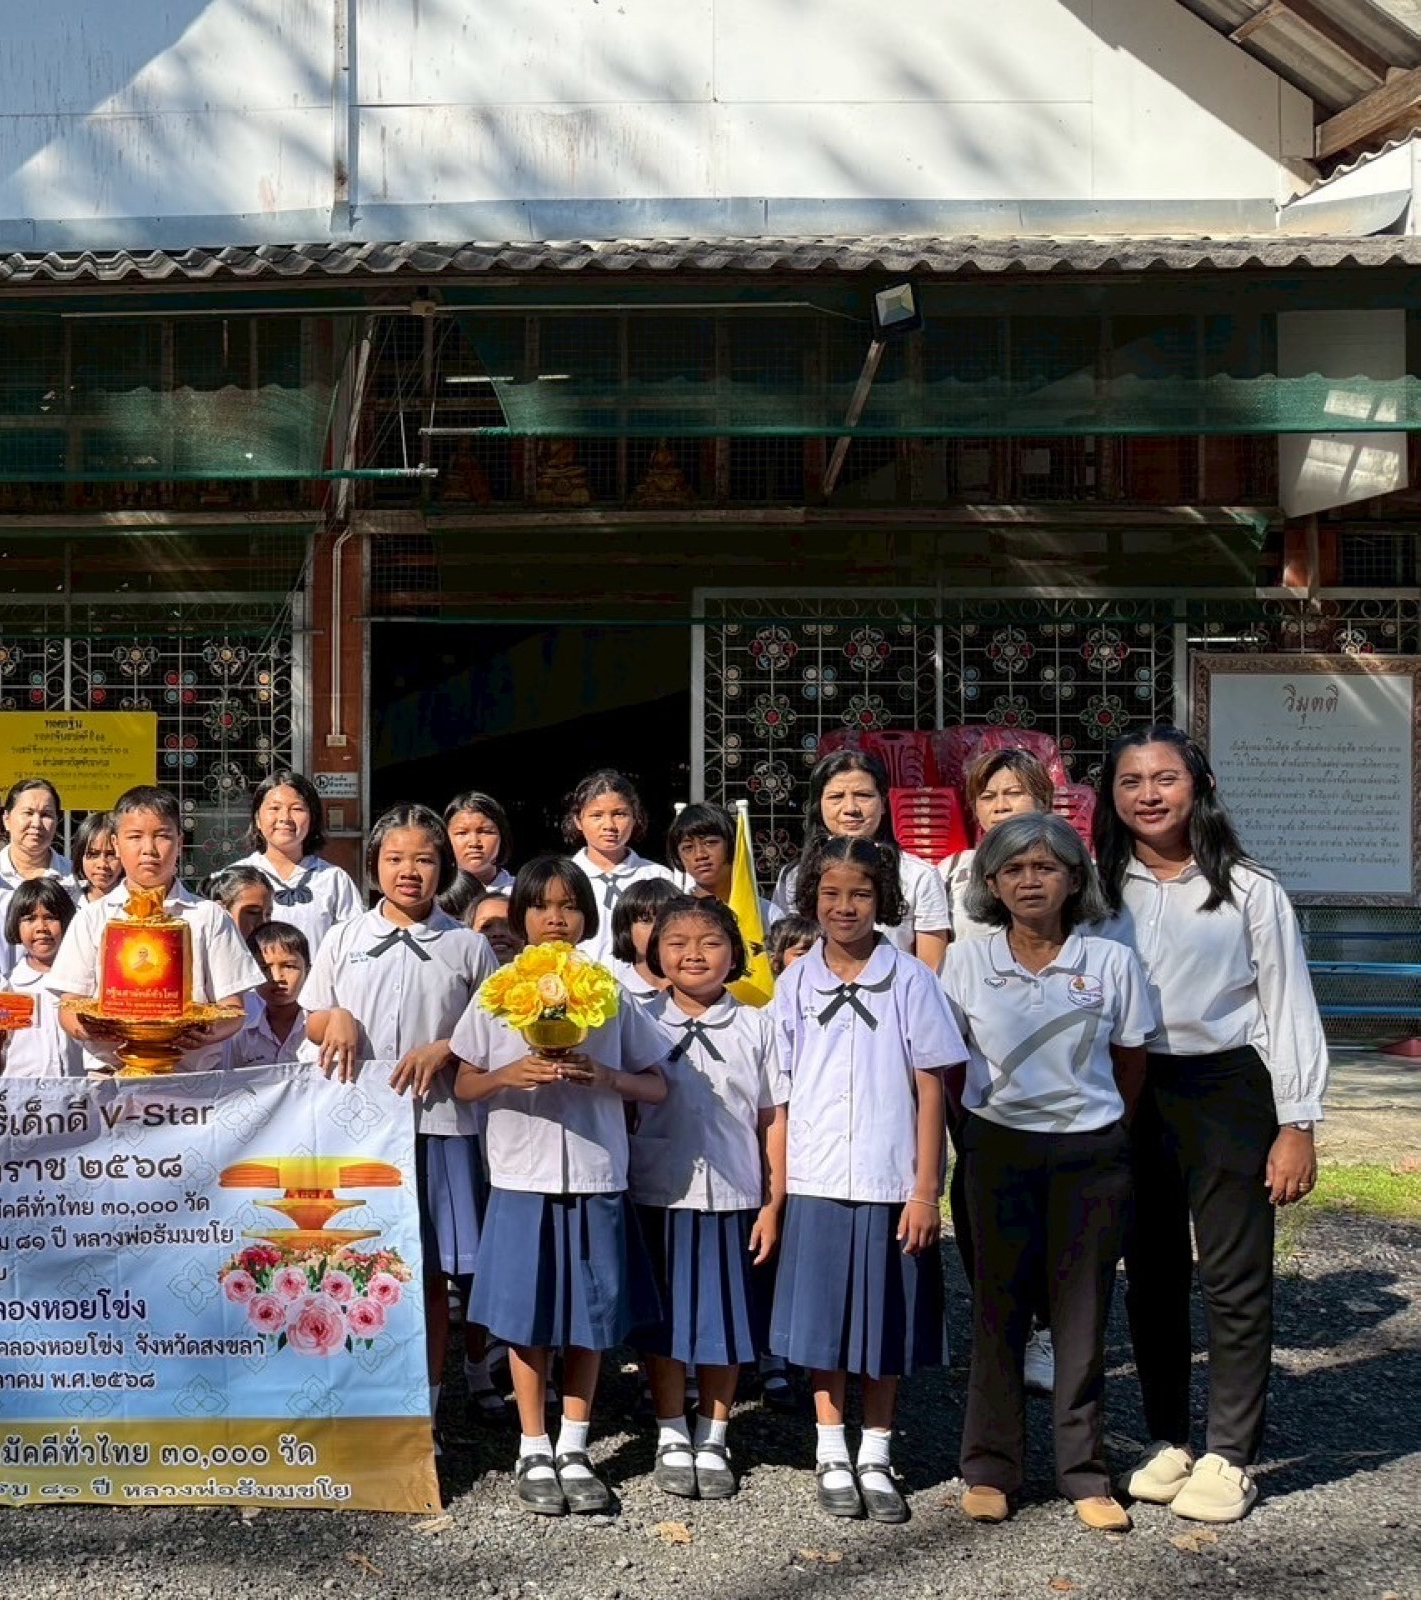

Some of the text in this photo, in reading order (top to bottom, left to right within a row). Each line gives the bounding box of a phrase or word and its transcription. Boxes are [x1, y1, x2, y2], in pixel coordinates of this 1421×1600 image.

[99, 1102, 215, 1130] V-Star
[78, 1152, 183, 1180] ๒๕๖๘
[101, 1199, 178, 1217] ๓๐,๐๐๐
[184, 1191, 211, 1213] วัด
[16, 1235, 46, 1251] ๘๑
[51, 1224, 67, 1249] ปี
[73, 1220, 234, 1248] หลวงพ่อธัมมชโย
[135, 1333, 265, 1357] จังหวัดสงขลา
[51, 1370, 155, 1390] พ.ศ.๒๕๖๘
[160, 1443, 268, 1469] ๓๐,๐๐๐
[279, 1434, 316, 1466] วัด
[91, 1475, 112, 1497] ปี
[123, 1477, 351, 1500] หลวงพ่อธัมมชโย
